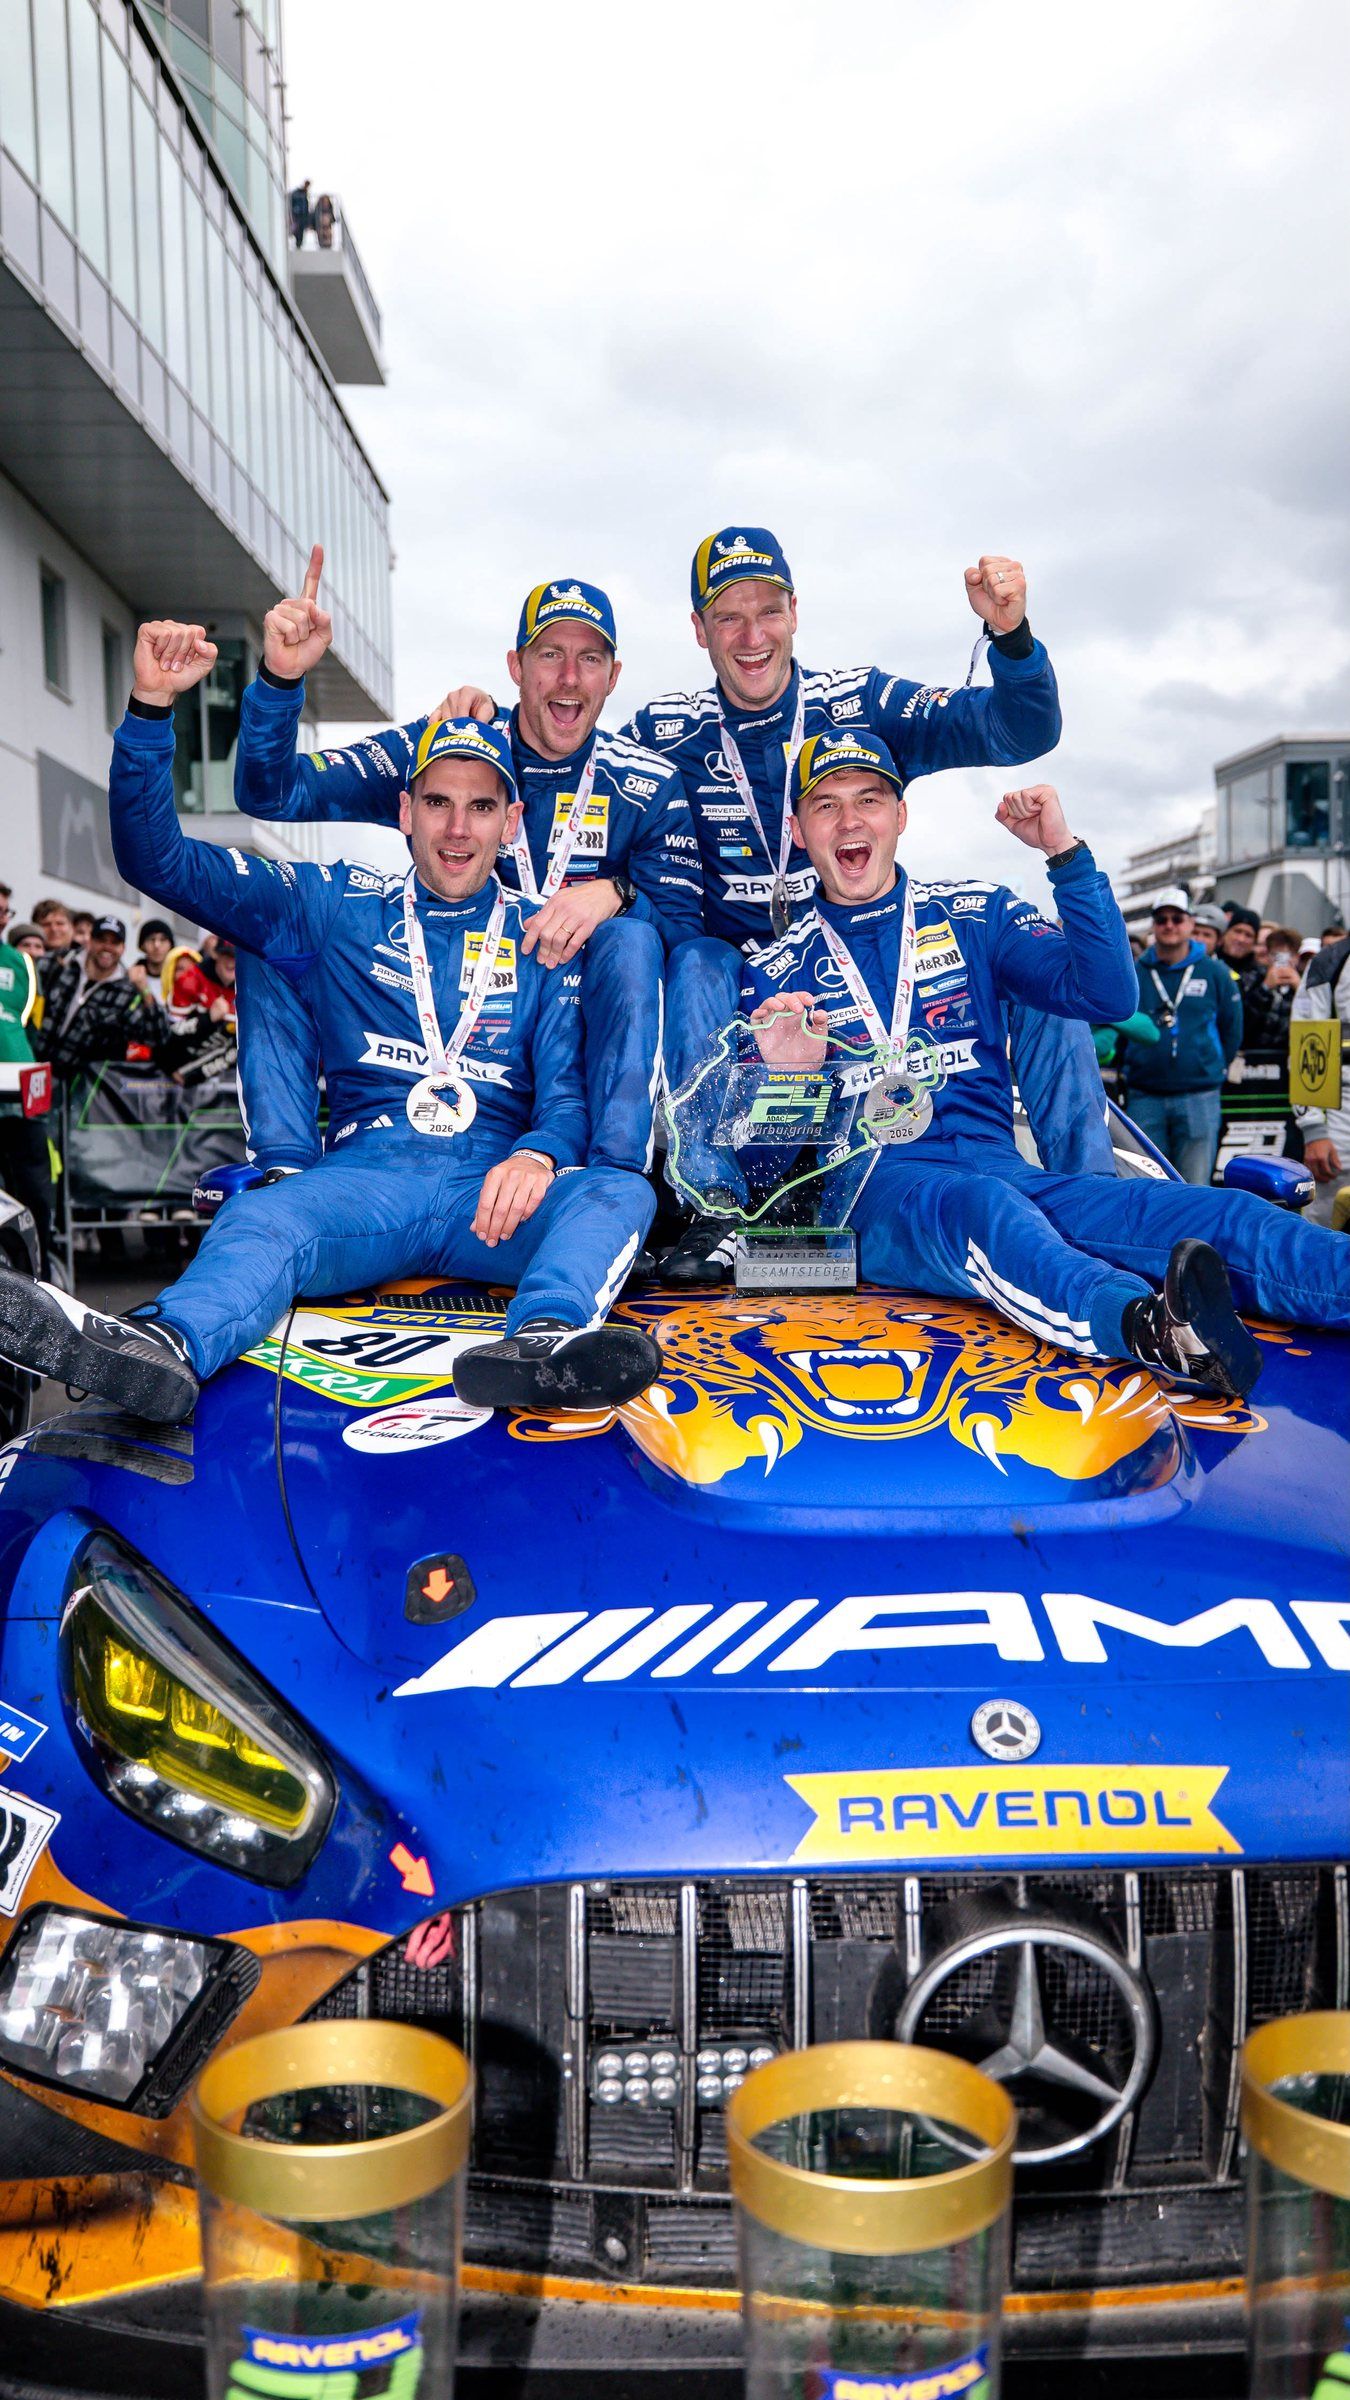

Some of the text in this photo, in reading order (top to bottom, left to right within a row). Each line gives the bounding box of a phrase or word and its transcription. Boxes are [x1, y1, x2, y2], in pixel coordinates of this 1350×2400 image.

[709, 556, 773, 578] MICHELIN
[538, 602, 603, 620] MICHELIN
[831, 699, 861, 717] OMP
[655, 722, 684, 736] OMP
[431, 738, 500, 759] MICHELIN
[813, 750, 880, 771] MICHELIN
[624, 777, 657, 795] OMP
[720, 828, 740, 837] IWC
[670, 854, 703, 870] TECHEM
[953, 896, 987, 911] OMP
[766, 951, 795, 977] OMP
[915, 955, 943, 973] H&R
[377, 967, 413, 987] RAVENO
[768, 1074, 827, 1082] RAVENOL
[429, 1124, 453, 1133] 2026
[889, 1128, 914, 1139] 2026
[828, 1146, 851, 1163] OMP
[193, 1189, 223, 1200] AMG
[742, 1266, 850, 1278] GESAMTSIEGER
[372, 1313, 507, 1328] RAVEN
[302, 1331, 451, 1368] 80
[246, 1346, 389, 1401] EKRA
[396, 1406, 485, 1417] INTERCONTINENTAL
[367, 1429, 445, 1441] CHALLENGE
[839, 1791, 1192, 1832] RAVENOL
[253, 2328, 412, 2368] RAVENOL
